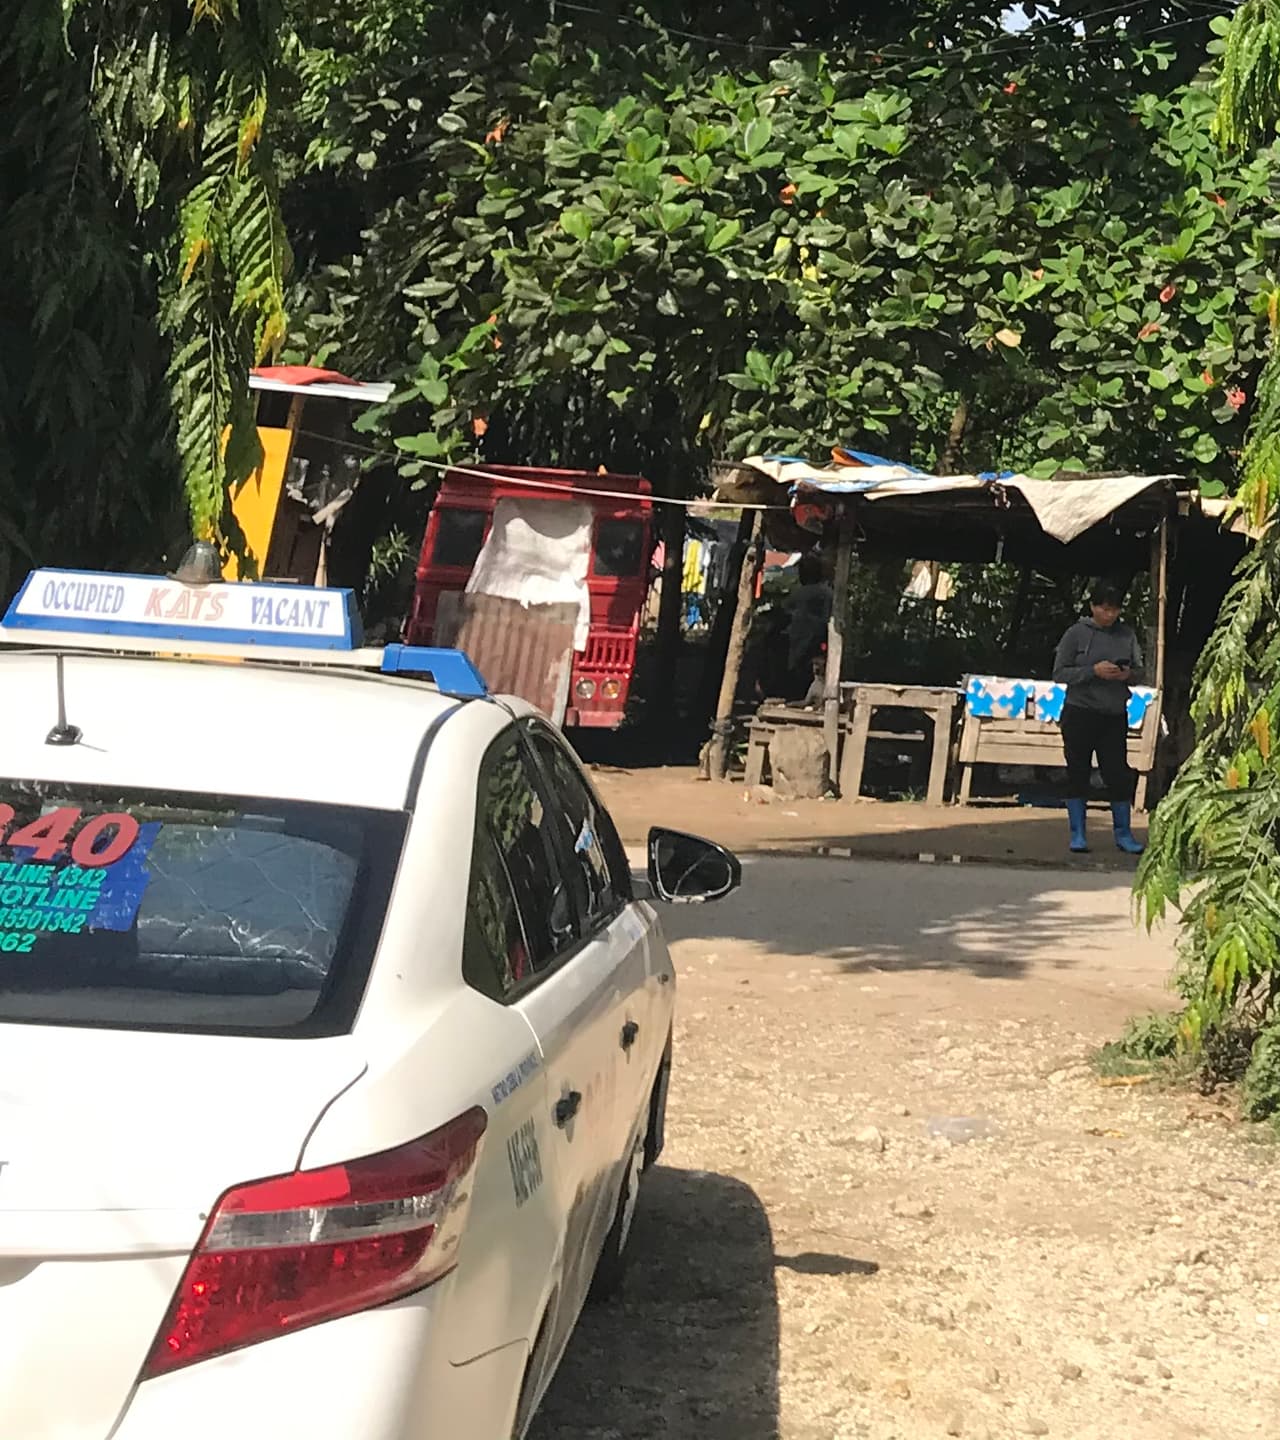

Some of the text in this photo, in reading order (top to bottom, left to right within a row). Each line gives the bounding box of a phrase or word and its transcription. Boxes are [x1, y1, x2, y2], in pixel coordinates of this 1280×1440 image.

[42, 580, 331, 629] OCCUPIED KATS VACANT
[57, 866, 107, 888] 1342
